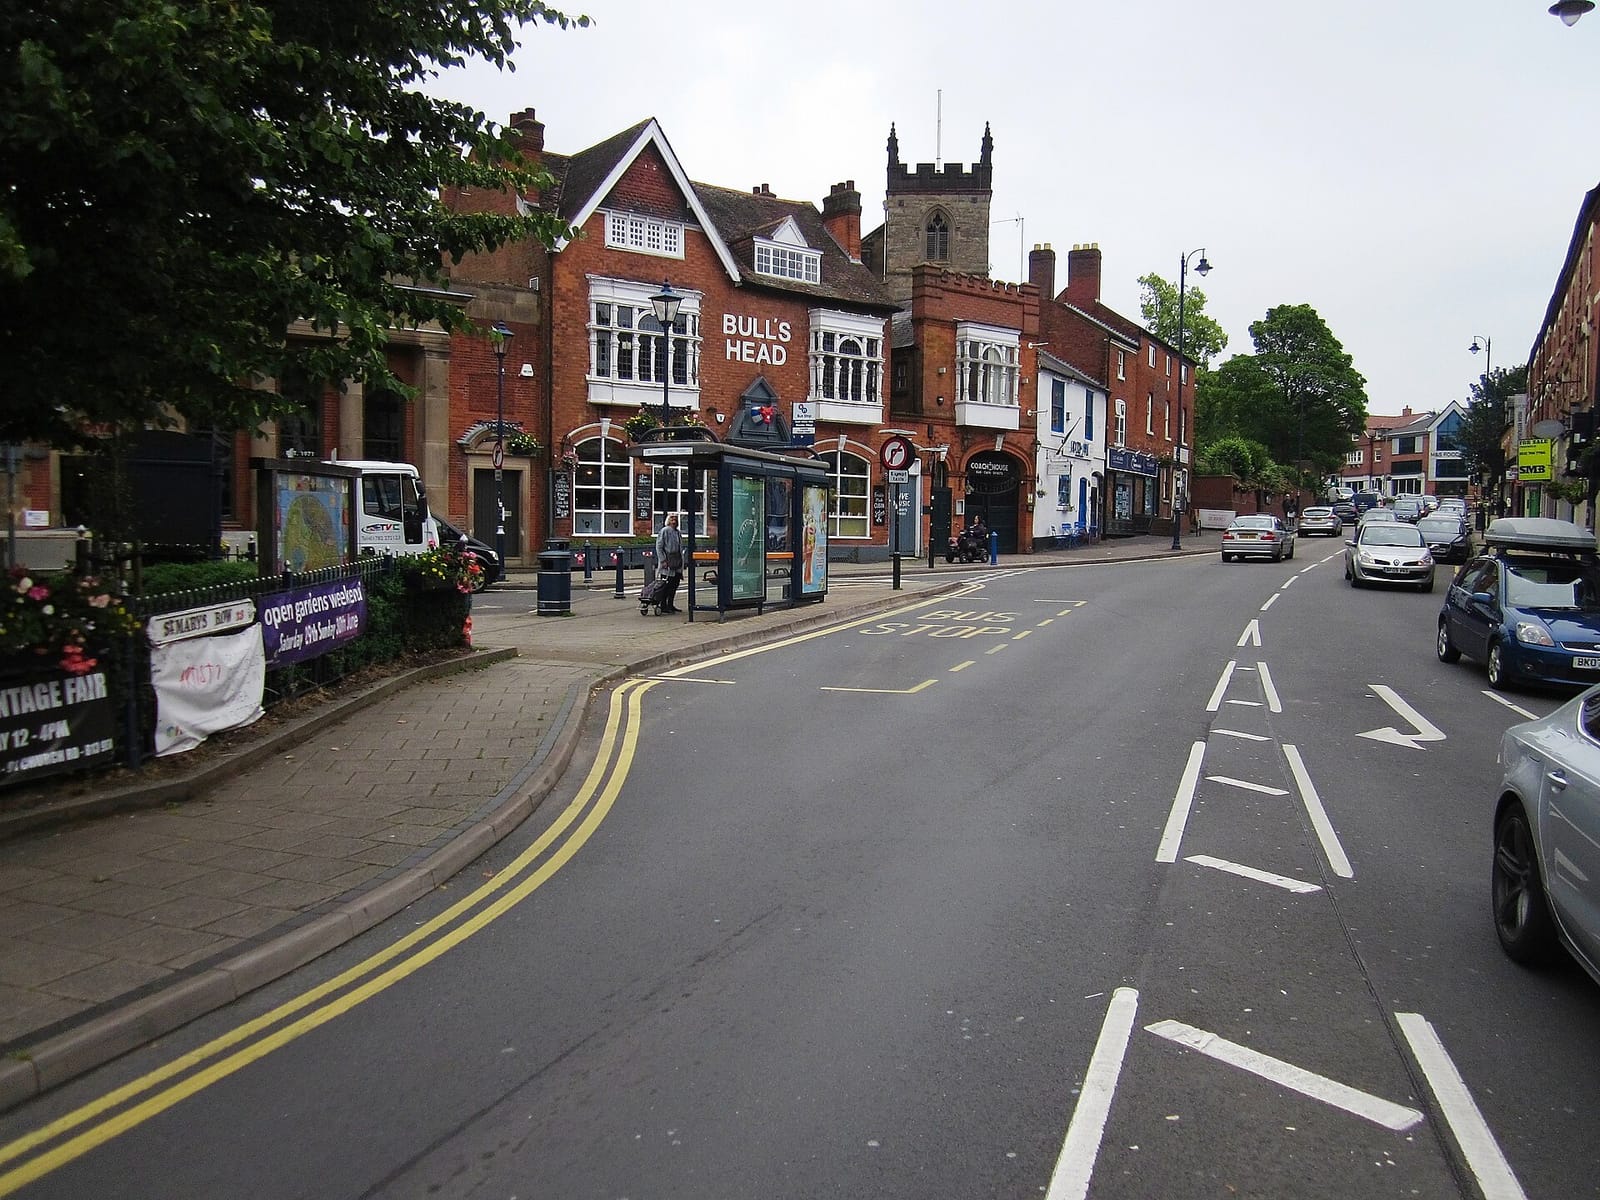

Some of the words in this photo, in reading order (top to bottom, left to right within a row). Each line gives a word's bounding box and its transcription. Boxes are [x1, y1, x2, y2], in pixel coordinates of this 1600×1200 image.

[723, 313, 791, 342] BULL'S
[726, 339, 787, 366] HEAD
[971, 462, 988, 470] COACH
[1520, 465, 1545, 473] SMB
[379, 523, 400, 531] TVC
[264, 603, 294, 629] open
[295, 592, 329, 624] gardens
[328, 581, 363, 609] weekend
[917, 609, 1023, 623] BUS
[859, 622, 1012, 639] STOP
[64, 672, 108, 705] FAIR
[11, 728, 30, 749] 12
[39, 719, 71, 742] 4PM
